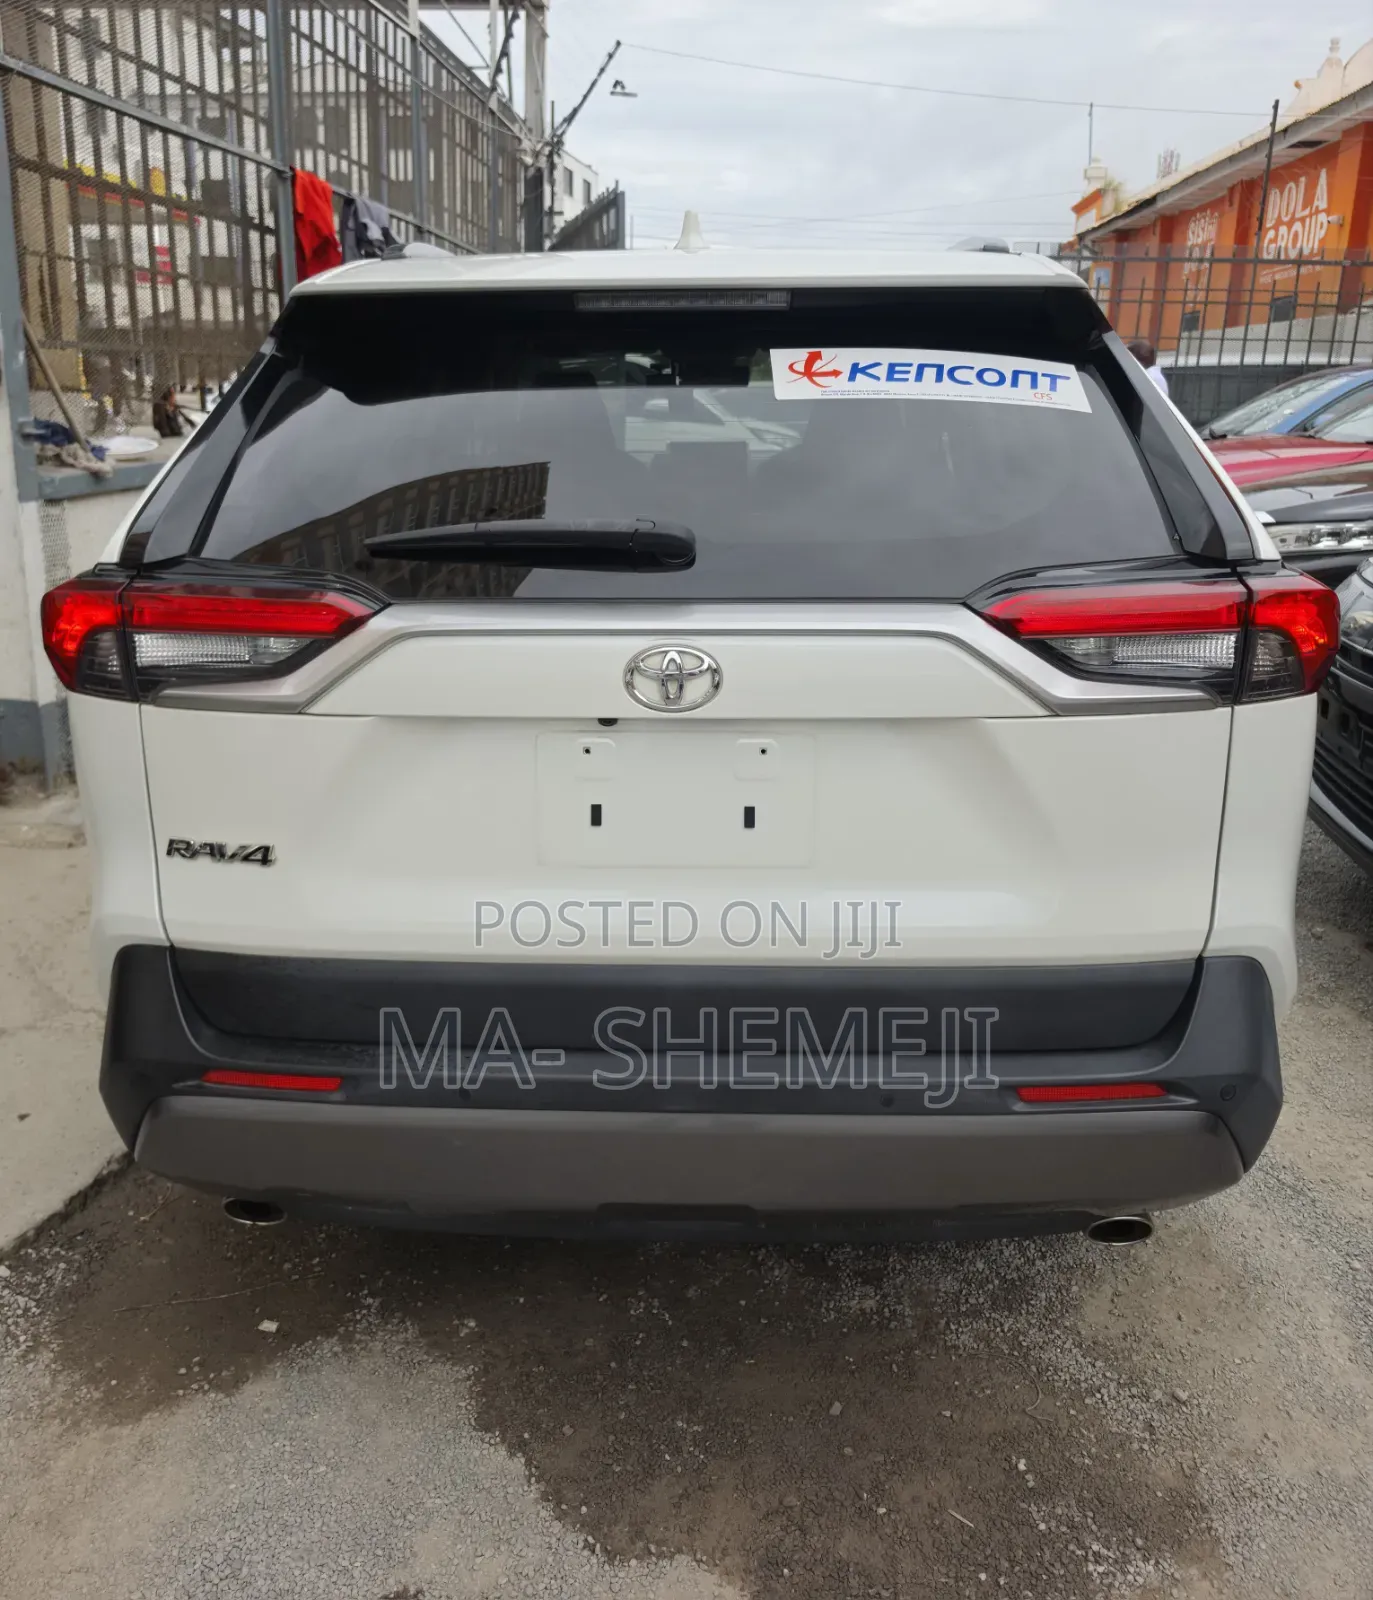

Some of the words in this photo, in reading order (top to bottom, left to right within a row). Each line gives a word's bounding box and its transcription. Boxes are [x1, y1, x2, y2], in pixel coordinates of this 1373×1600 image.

[1266, 168, 1328, 228] DOLA
[1263, 212, 1328, 260] GROUP
[1033, 392, 1053, 401] CFS
[166, 837, 277, 867] RAV4
